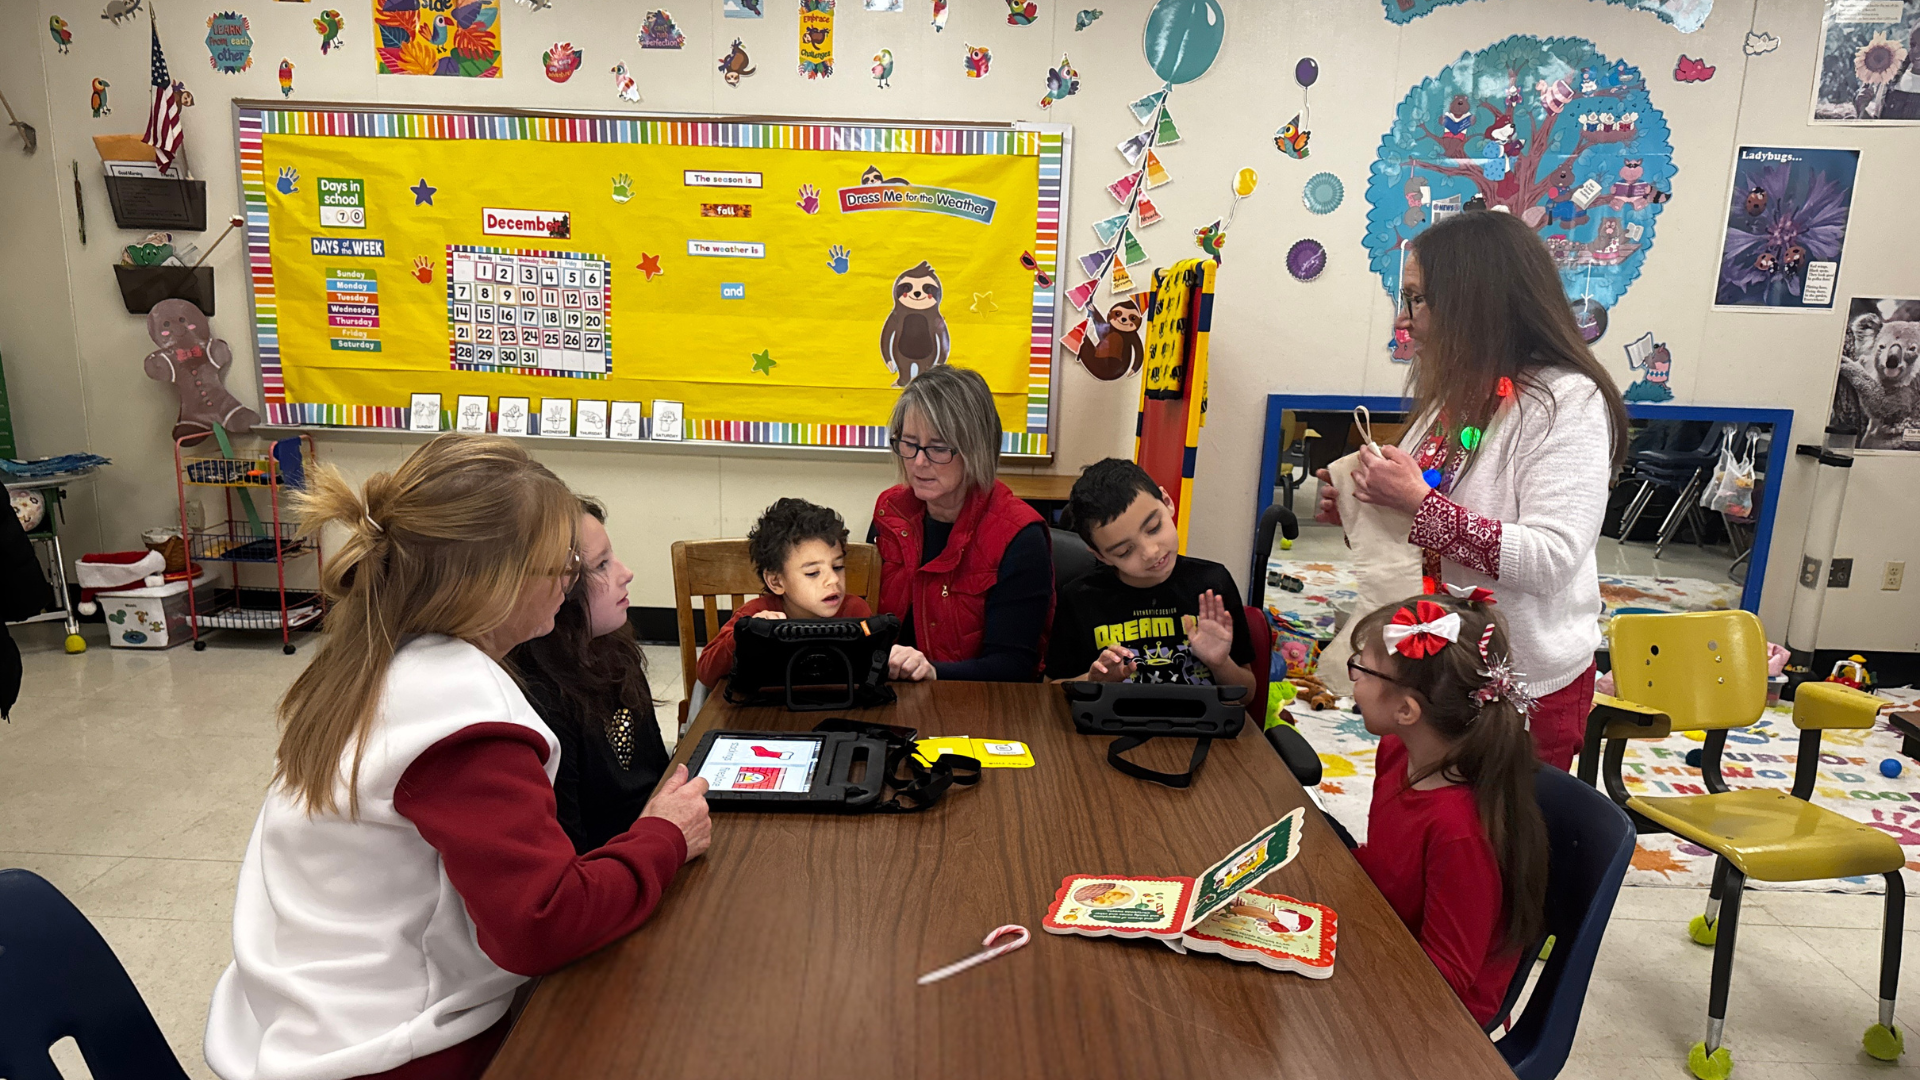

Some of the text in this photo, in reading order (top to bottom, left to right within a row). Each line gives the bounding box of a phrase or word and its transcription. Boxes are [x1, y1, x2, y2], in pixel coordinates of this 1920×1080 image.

[803, 13, 830, 23] Embrace
[213, 24, 242, 35] LEARN
[209, 36, 250, 46] from each
[217, 48, 245, 62] other
[801, 49, 831, 60] Challenges
[1741, 150, 1803, 163] Ladybugs...
[694, 174, 711, 182] The
[745, 176, 752, 184] is
[321, 179, 360, 194] Days in
[324, 193, 359, 205] school
[847, 190, 988, 215] Dress Me for the Weather
[717, 206, 735, 215] fall
[1439, 203, 1454, 212] NEWS
[339, 212, 360, 220] 7 0
[487, 213, 562, 232] December
[313, 239, 339, 254] DAYS
[352, 241, 383, 256] WEEK
[694, 243, 759, 254] The weather is
[336, 270, 365, 280] Sunday
[482, 266, 597, 284] 1 2 3 4 5 6
[336, 281, 367, 292] Monday
[723, 286, 743, 296] and
[336, 293, 369, 303] Tuesday
[458, 286, 599, 306] 7 8 9 10 11 12 13
[331, 305, 376, 315] Wednesday
[335, 317, 373, 327] Thursday
[456, 307, 601, 327] 14 15 16 17 18 19 20
[342, 329, 367, 339] Friday
[457, 327, 601, 348] 21 22 23 24 25 26 27
[338, 340, 374, 350] Saturday
[458, 347, 535, 363] 28 29 30 31
[1094, 617, 1175, 650] DREAM
